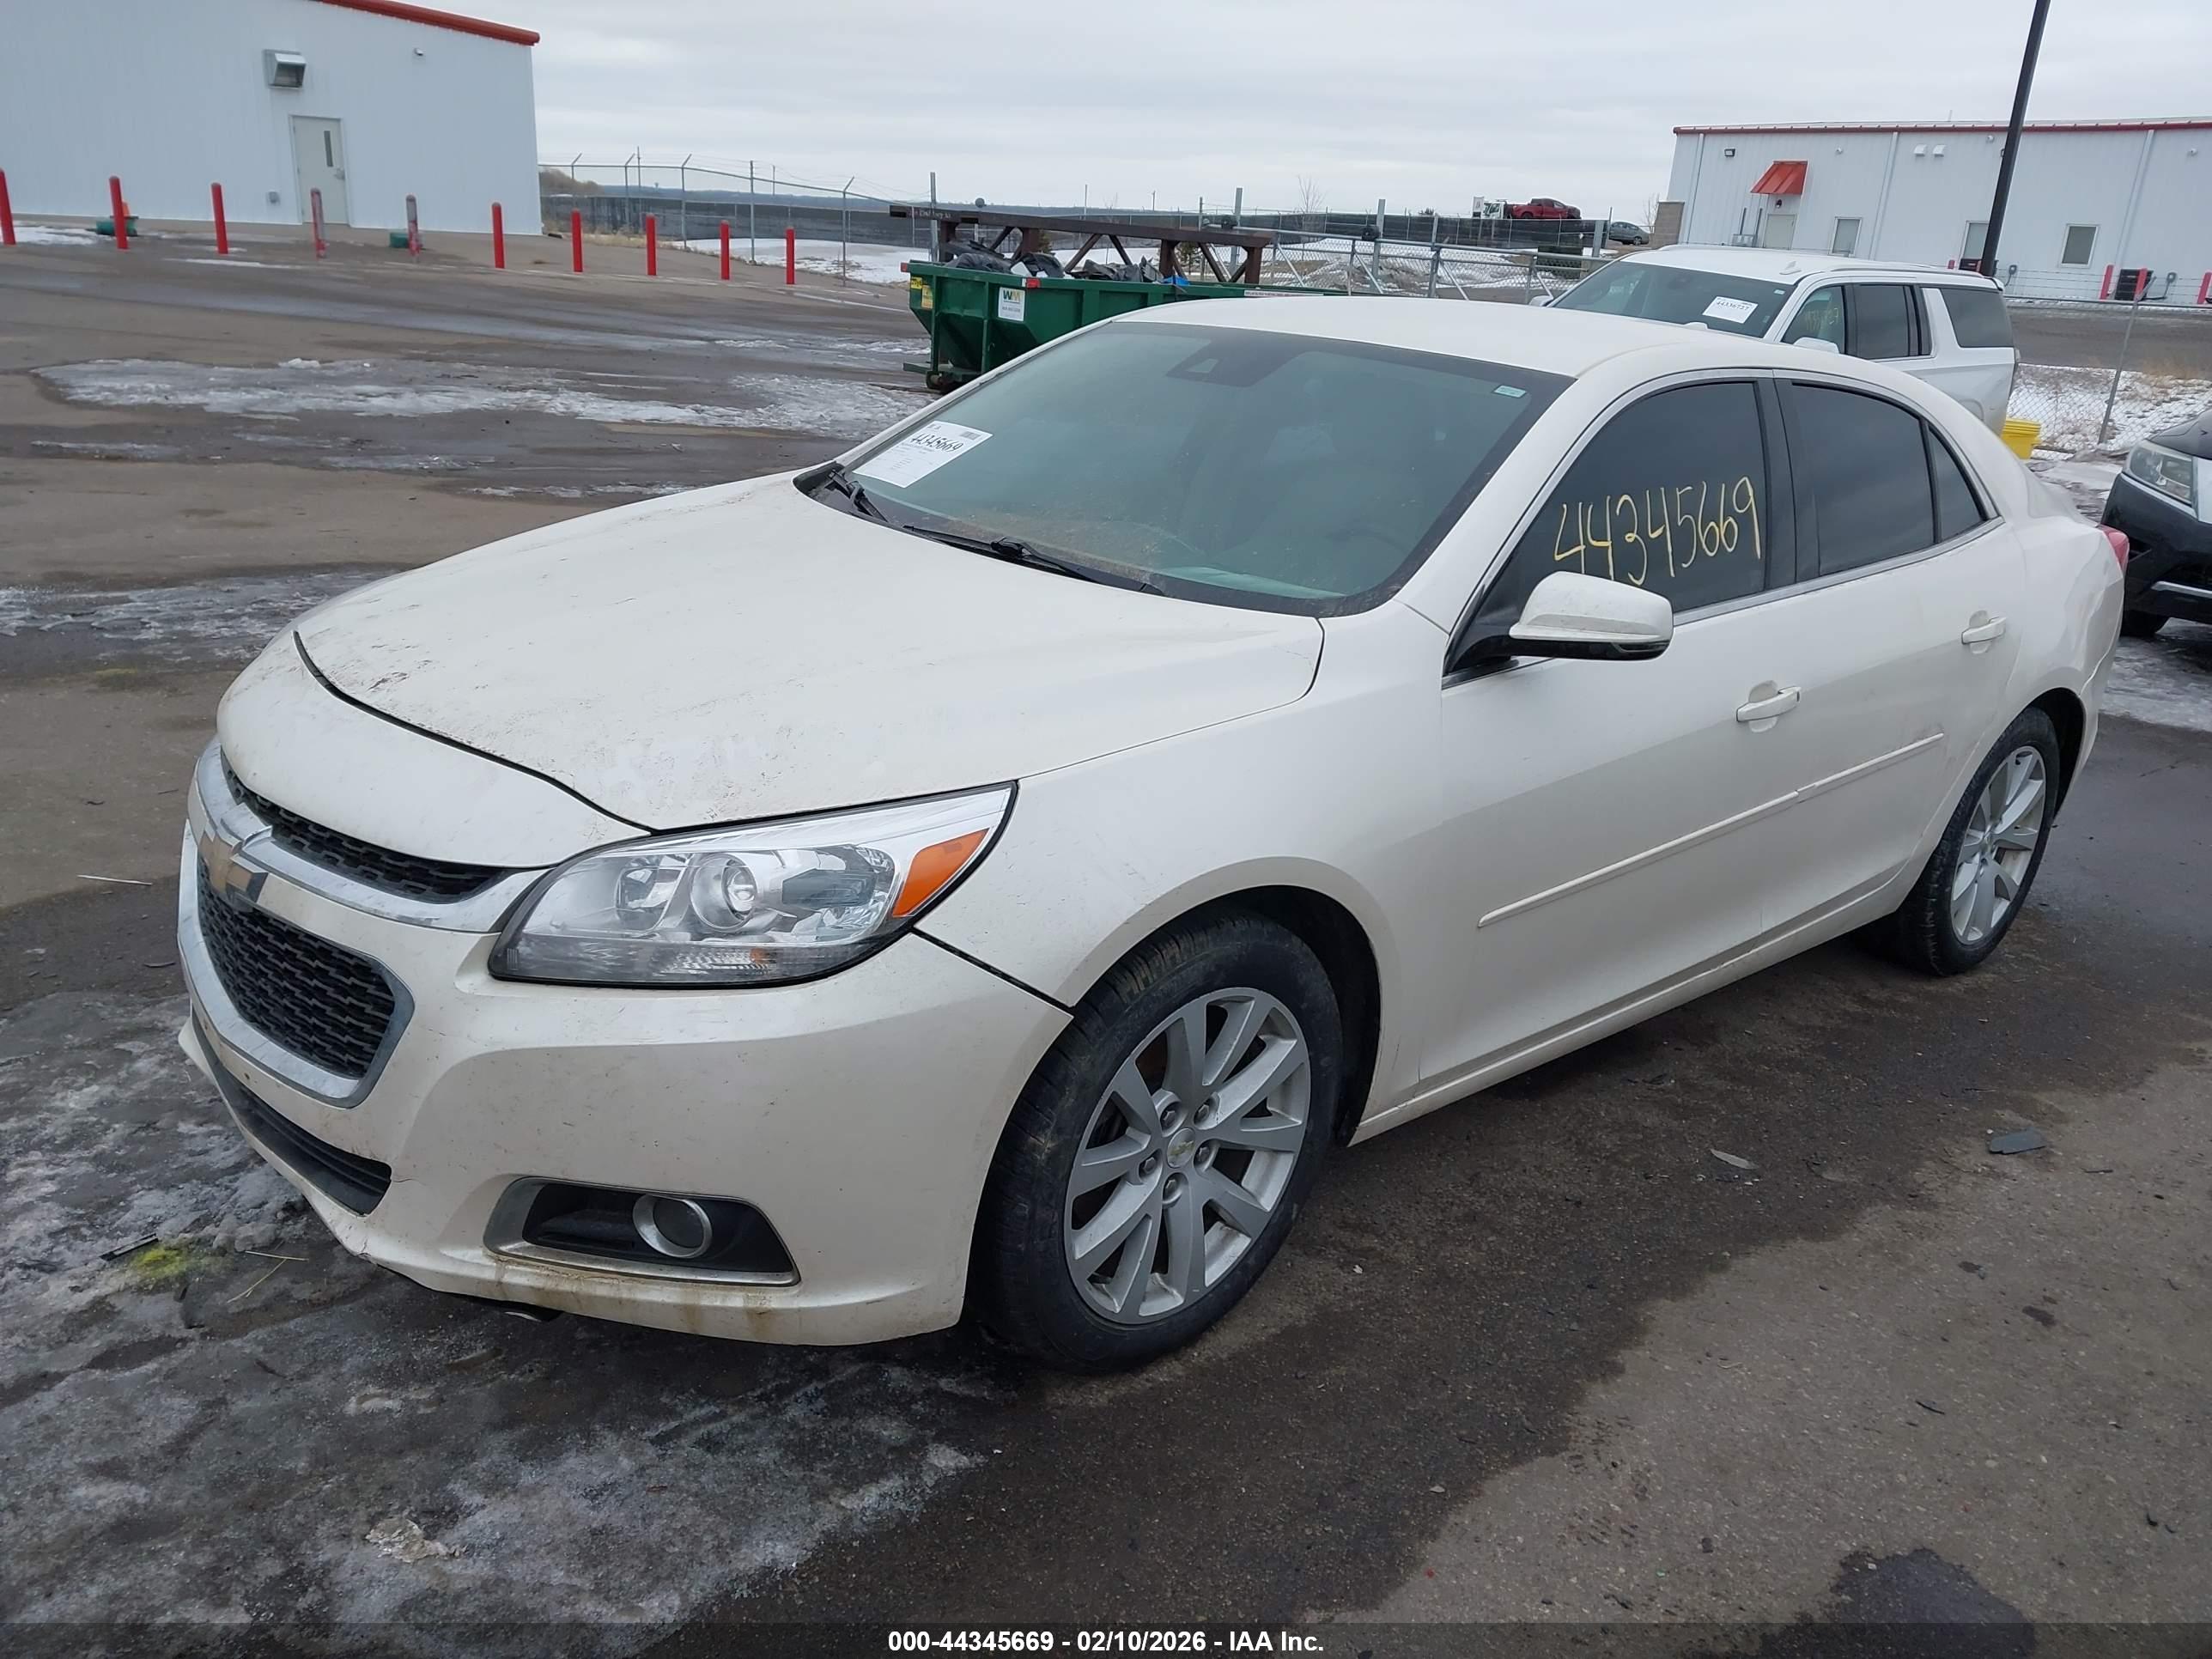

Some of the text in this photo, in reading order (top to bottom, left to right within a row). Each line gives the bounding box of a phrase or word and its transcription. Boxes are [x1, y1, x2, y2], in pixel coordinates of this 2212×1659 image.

[1002, 289, 1021, 302] WM
[910, 433, 963, 453] 44345669
[1554, 477, 1760, 586] 44345669
